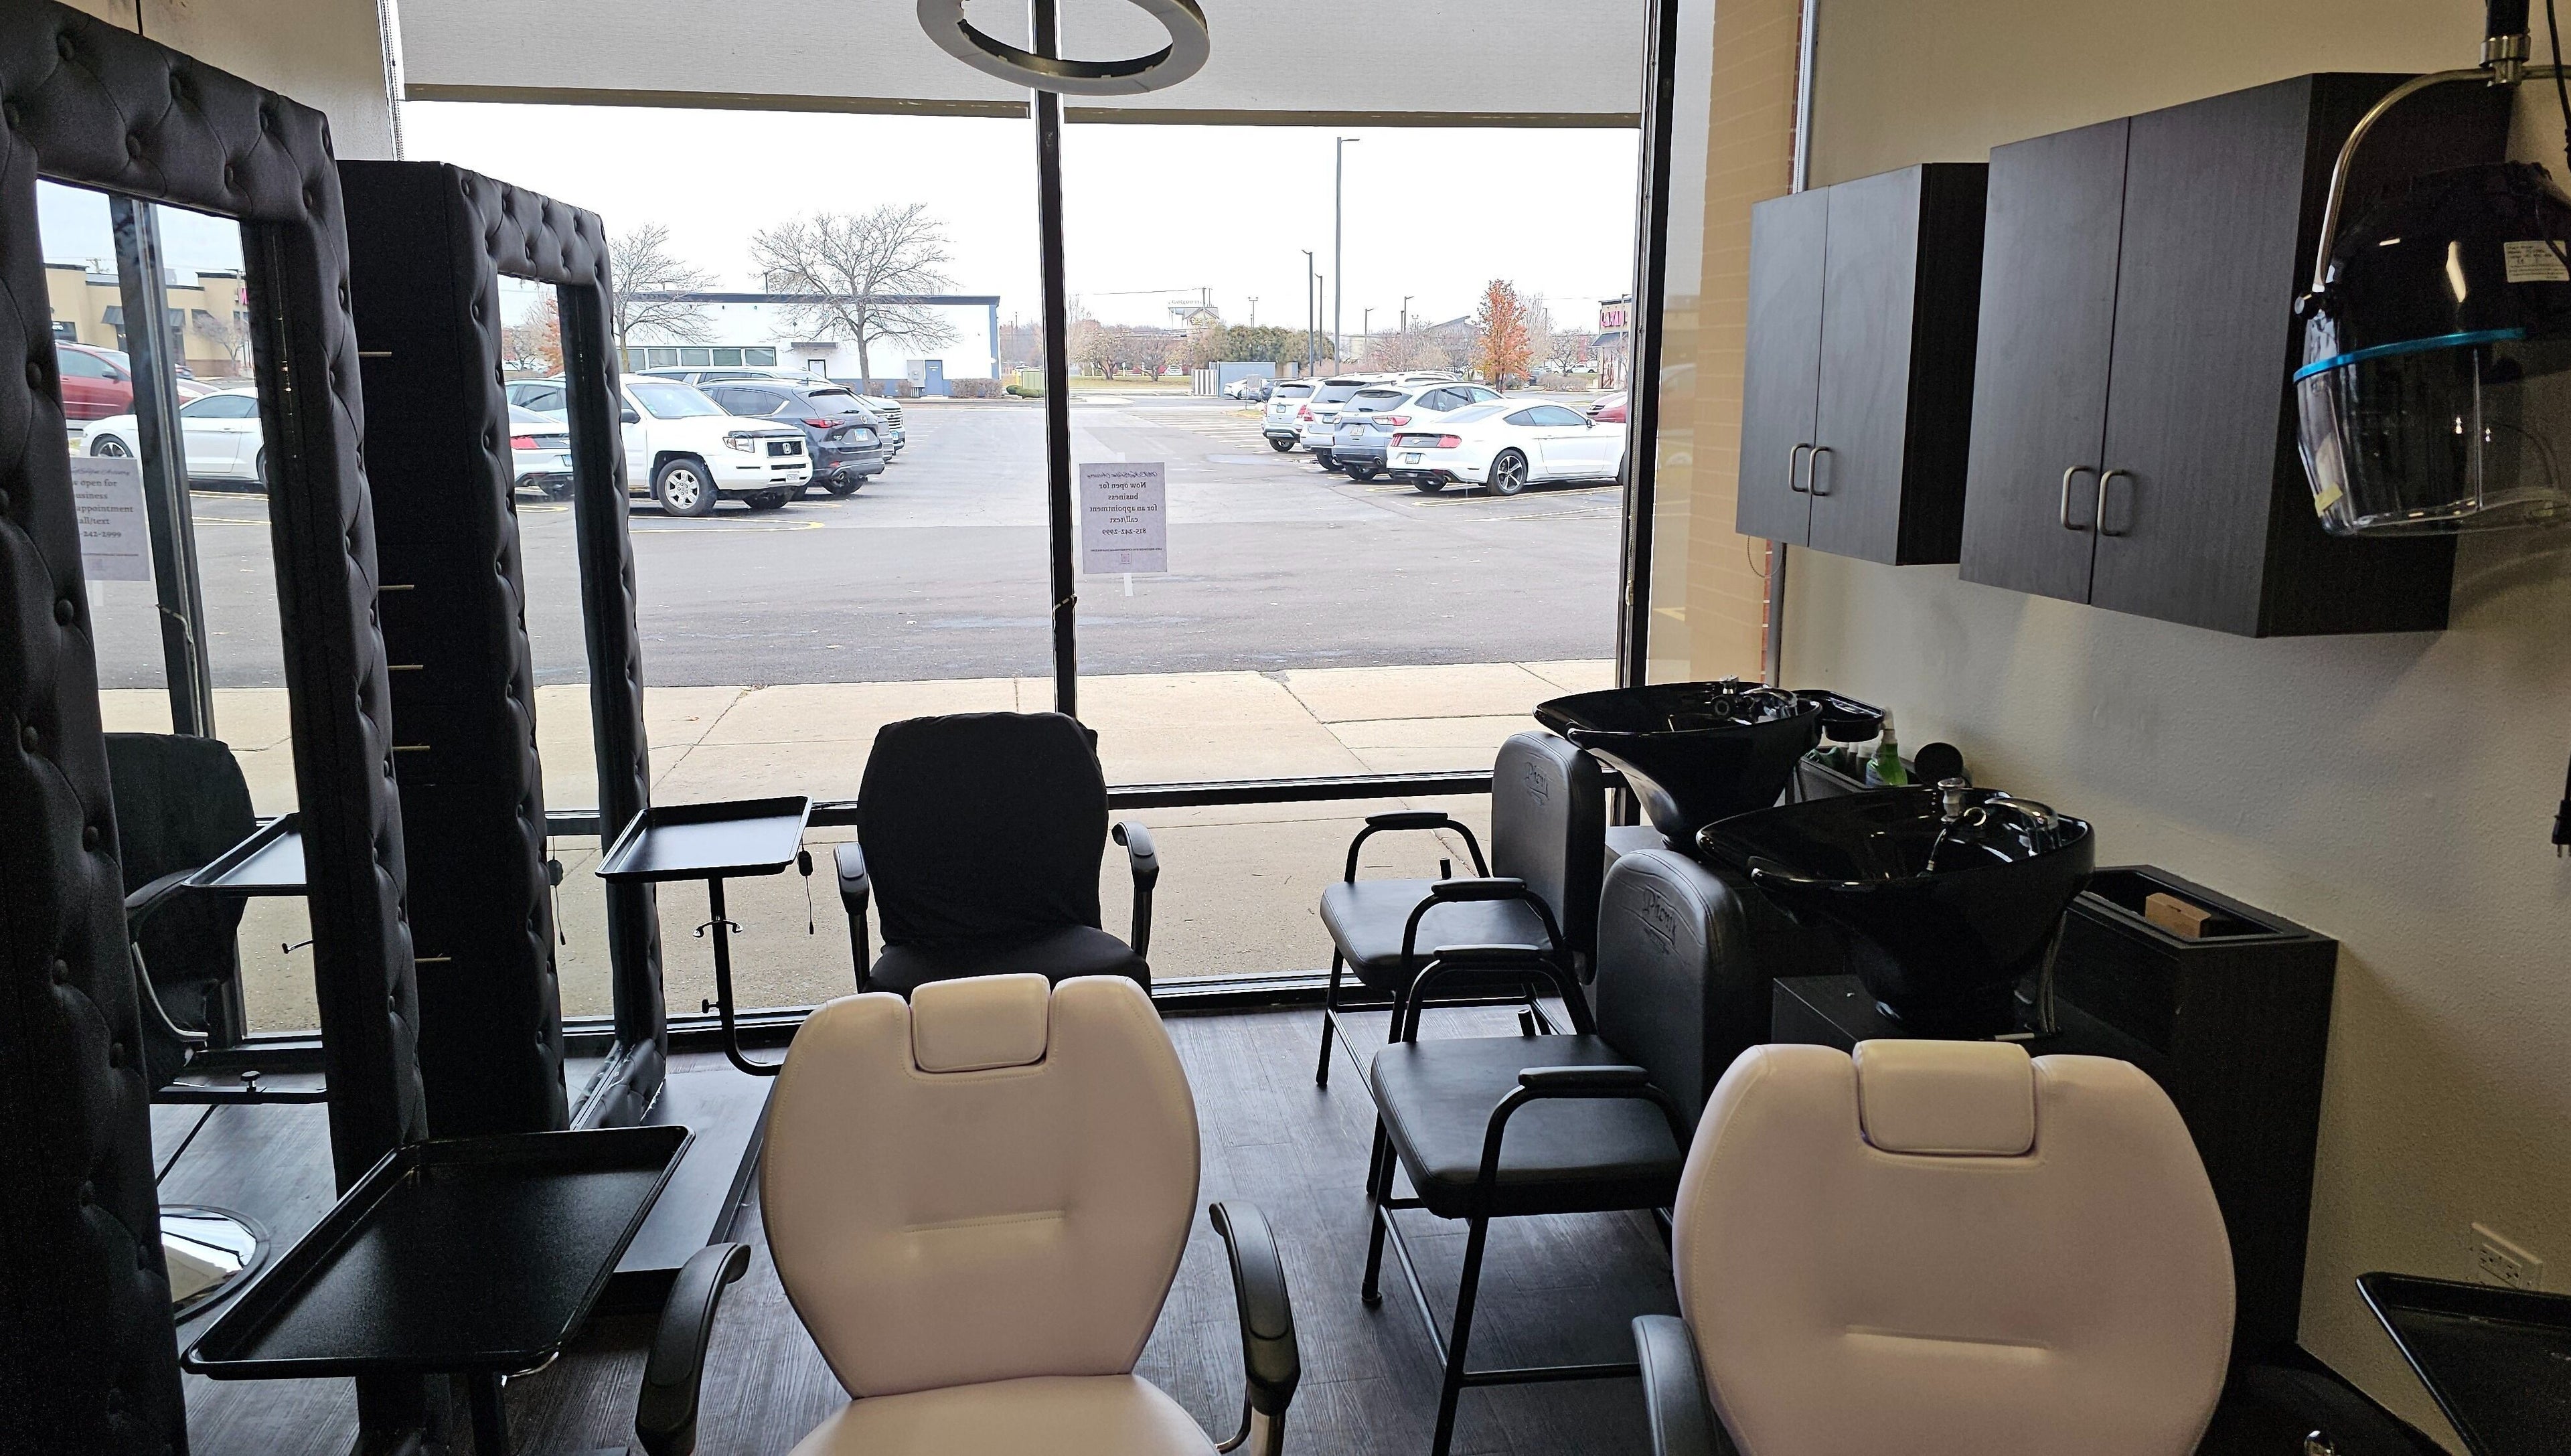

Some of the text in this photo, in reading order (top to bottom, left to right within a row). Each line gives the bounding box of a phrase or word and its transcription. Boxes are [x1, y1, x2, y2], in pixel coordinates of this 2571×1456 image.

[80, 480, 102, 488] open
[104, 479, 118, 487] for
[78, 516, 110, 525] all/text
